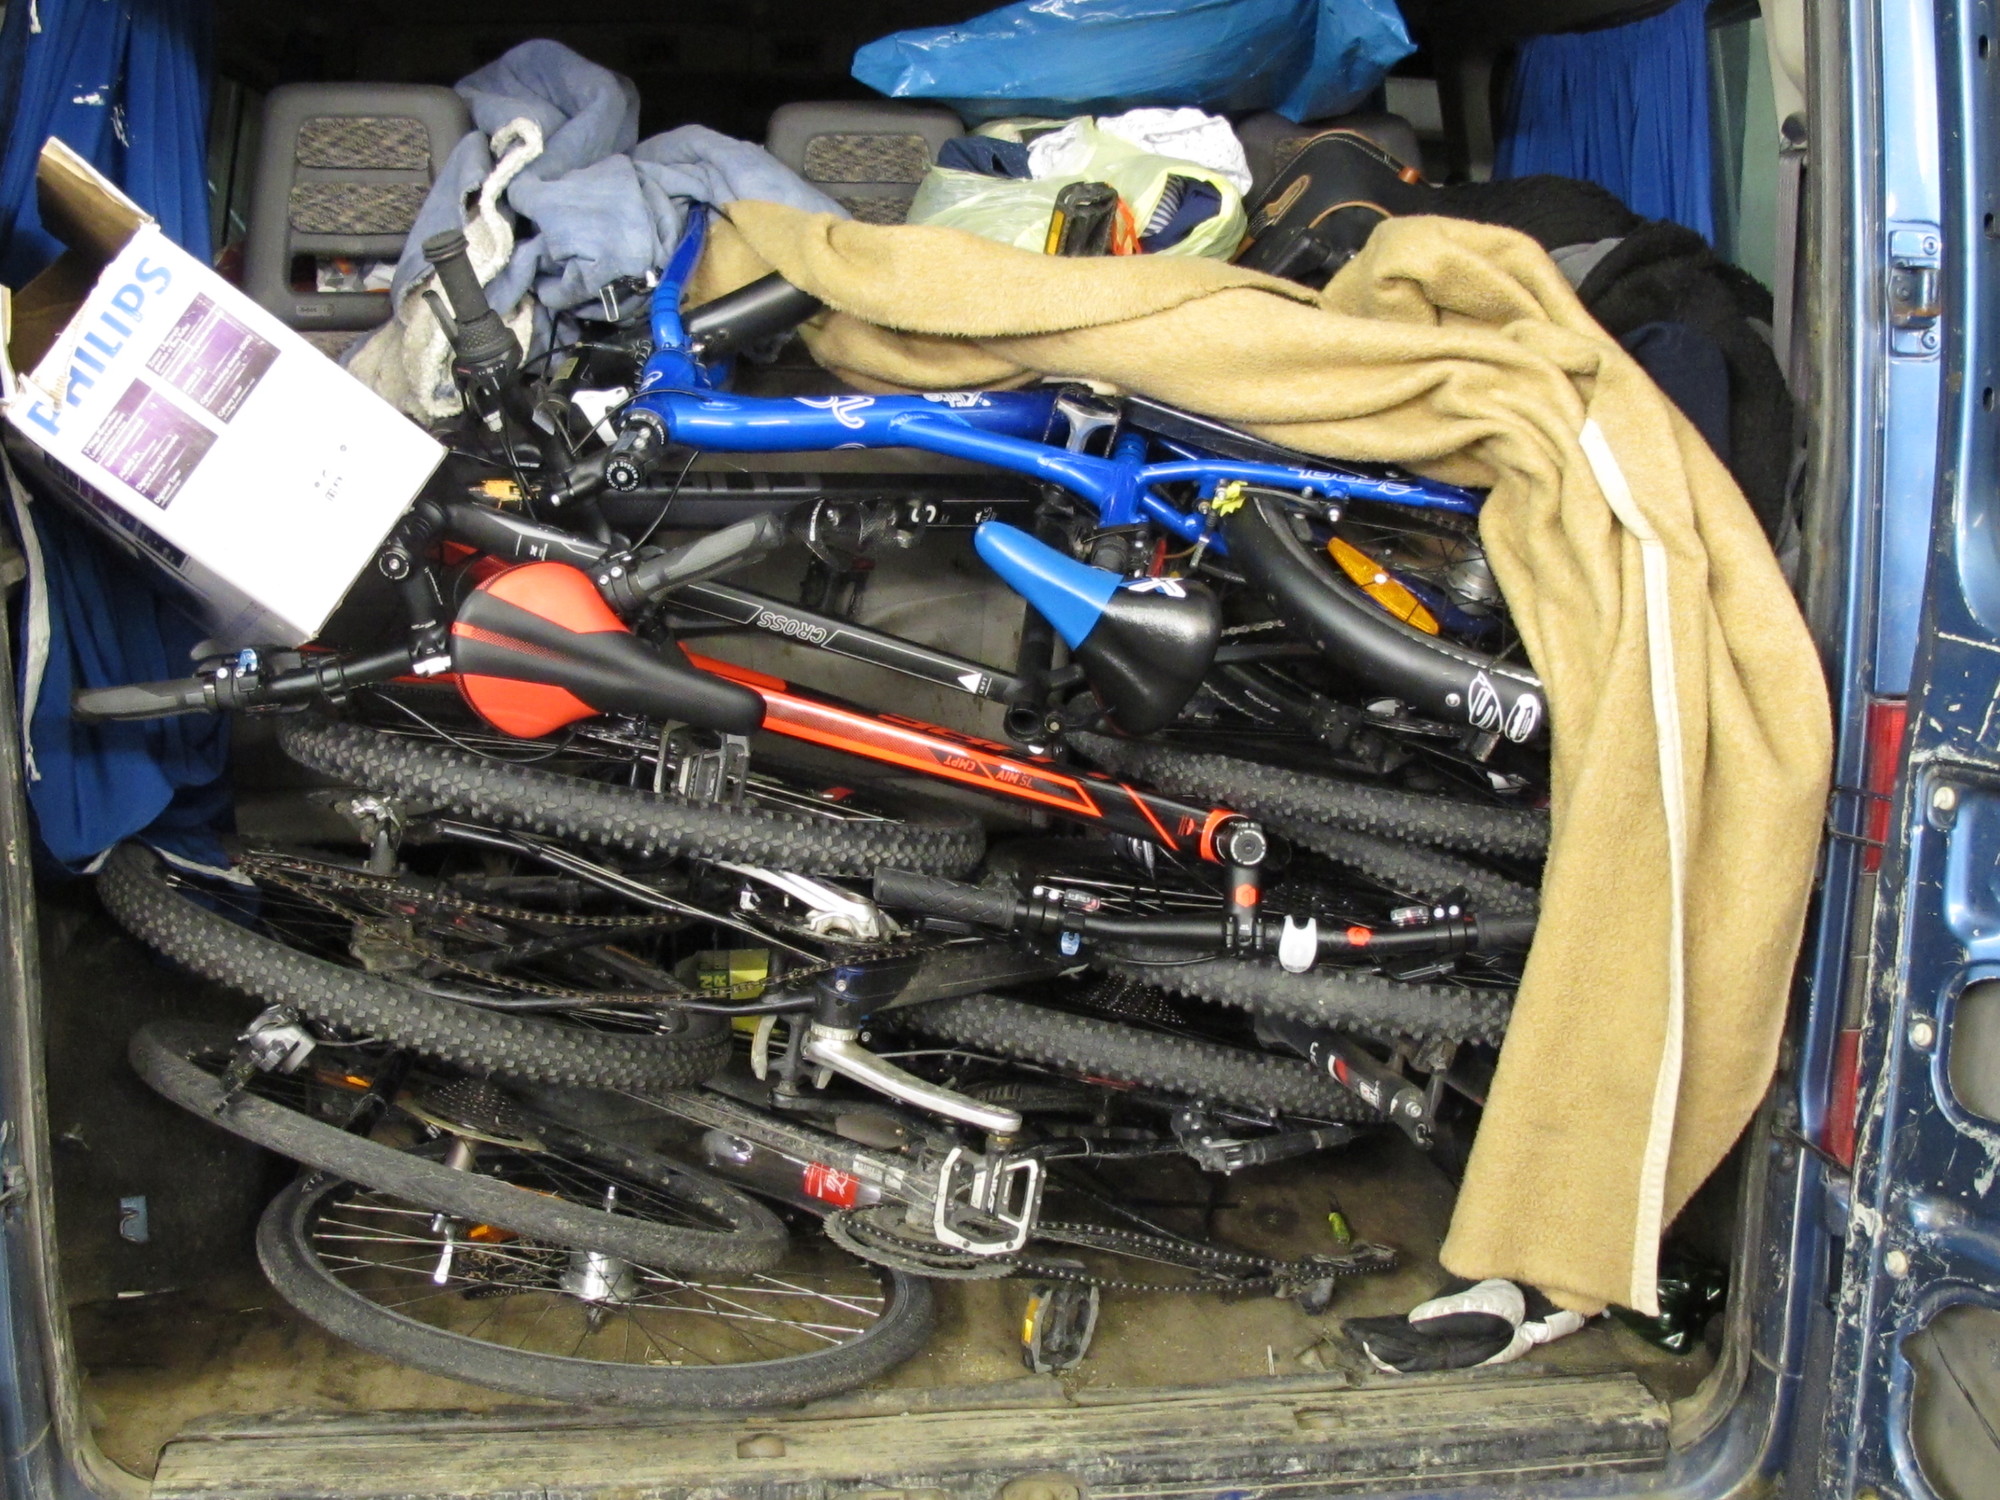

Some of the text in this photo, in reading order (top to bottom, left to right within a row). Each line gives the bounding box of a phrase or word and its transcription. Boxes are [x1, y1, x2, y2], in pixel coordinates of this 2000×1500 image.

[27, 257, 172, 436] PHILIPS
[757, 611, 827, 643] CROSS
[943, 755, 976, 772] CMPT
[996, 766, 1019, 784] AIM
